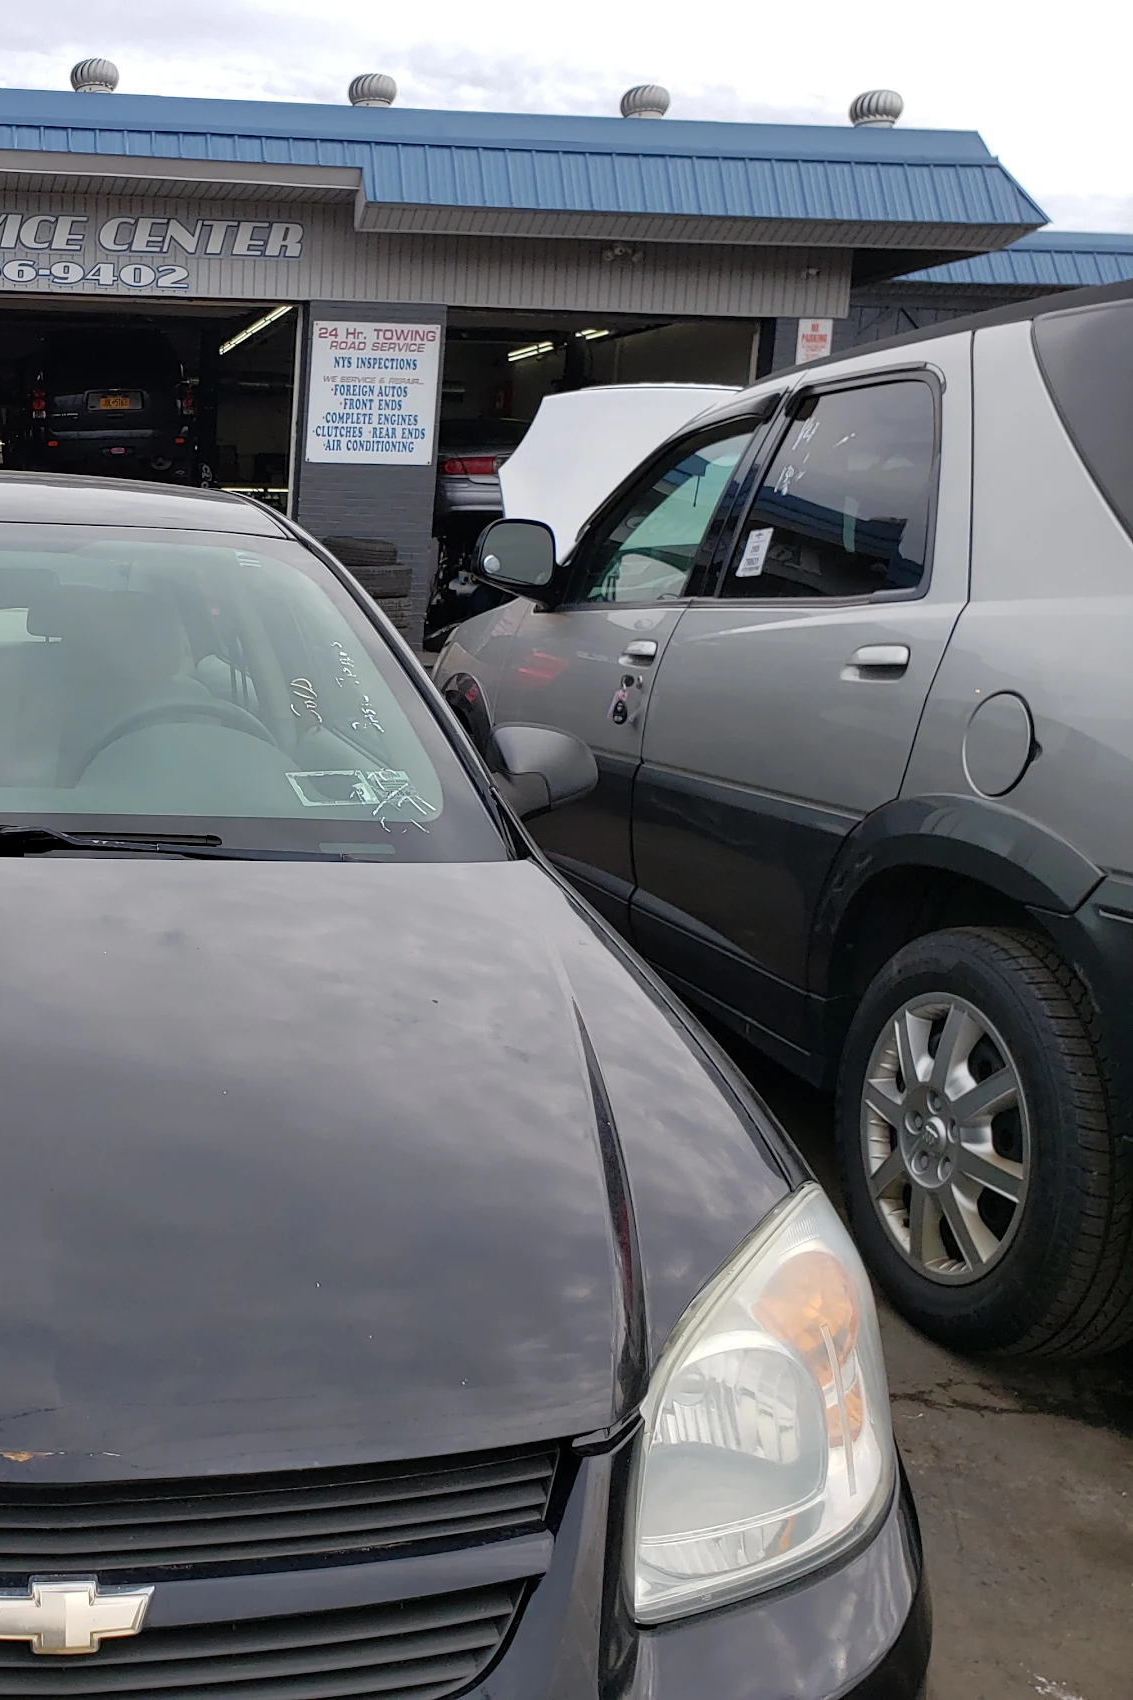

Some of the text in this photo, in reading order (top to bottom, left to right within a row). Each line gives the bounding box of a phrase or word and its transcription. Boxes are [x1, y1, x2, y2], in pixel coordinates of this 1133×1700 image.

[98, 216, 305, 258] CENTER
[318, 327, 436, 342] 24 Hr. TOWING
[329, 341, 425, 353] ROAD SERVICE
[334, 356, 417, 370] NYS INSPECTIONS
[323, 375, 337, 383] WE
[340, 376, 376, 384] SERVICE
[333, 384, 408, 398] FOREIGN AUTOS
[343, 398, 402, 411] FRONT ENDS
[325, 412, 418, 426] COMPLETE ENGINES
[315, 425, 425, 440] CLUTCHES REAR ENDS
[325, 439, 414, 452] AIR CONDITIONING
